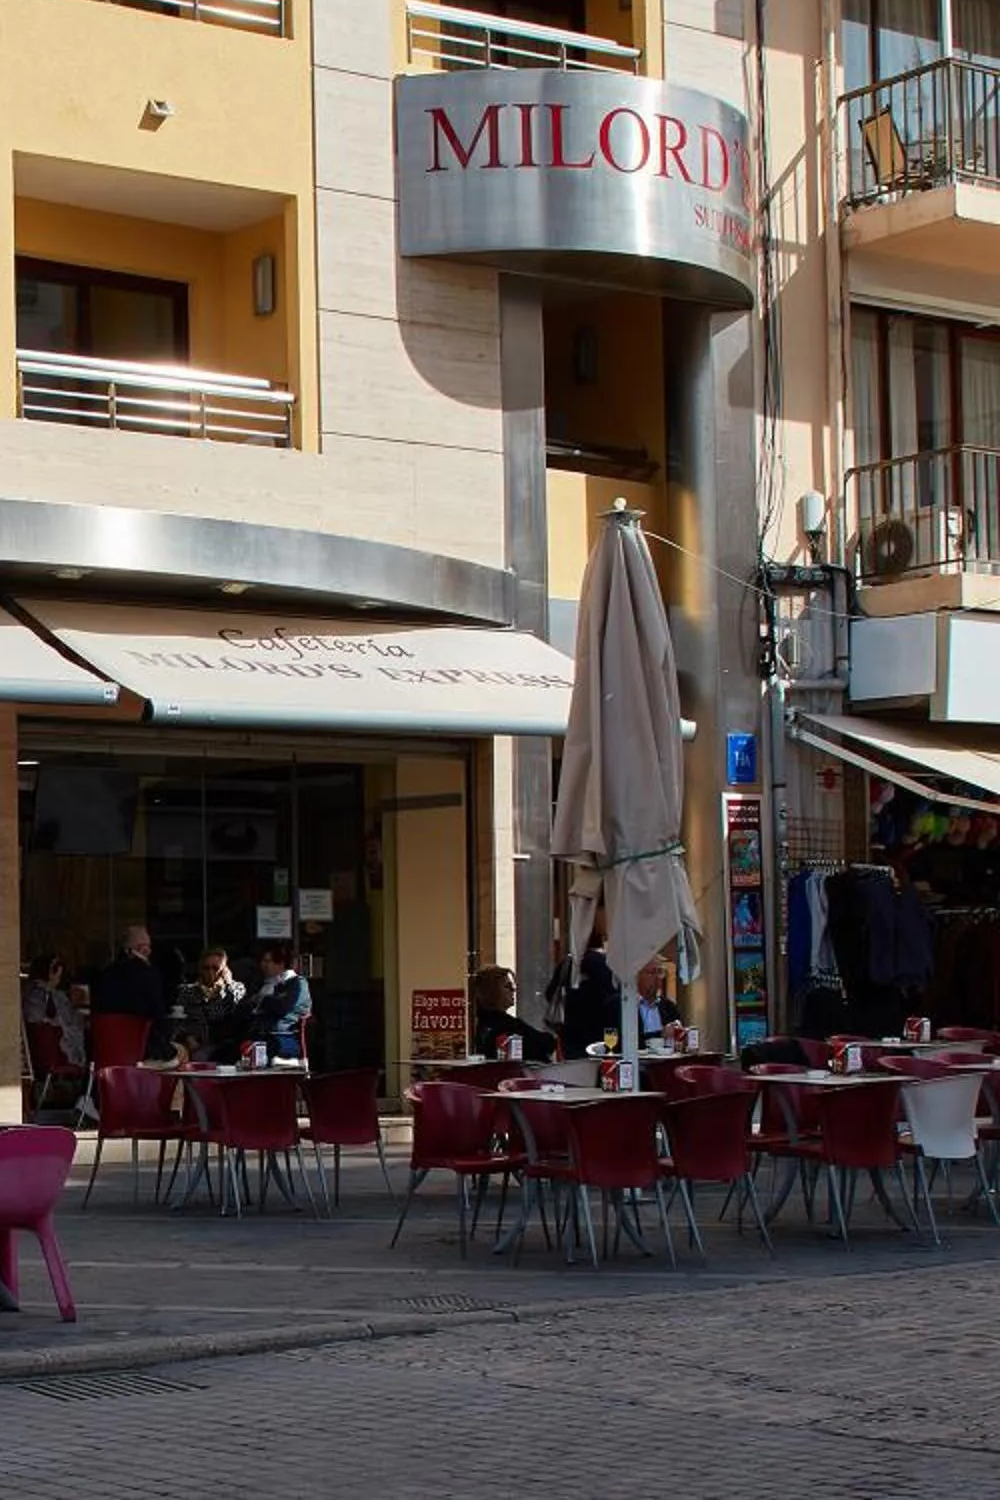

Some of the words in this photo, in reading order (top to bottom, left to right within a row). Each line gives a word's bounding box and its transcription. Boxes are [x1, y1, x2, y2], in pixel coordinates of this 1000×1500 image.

[123, 650, 362, 679] MILORD'S
[376, 662, 575, 688] EXPRESS
[413, 1011, 466, 1029] favori
